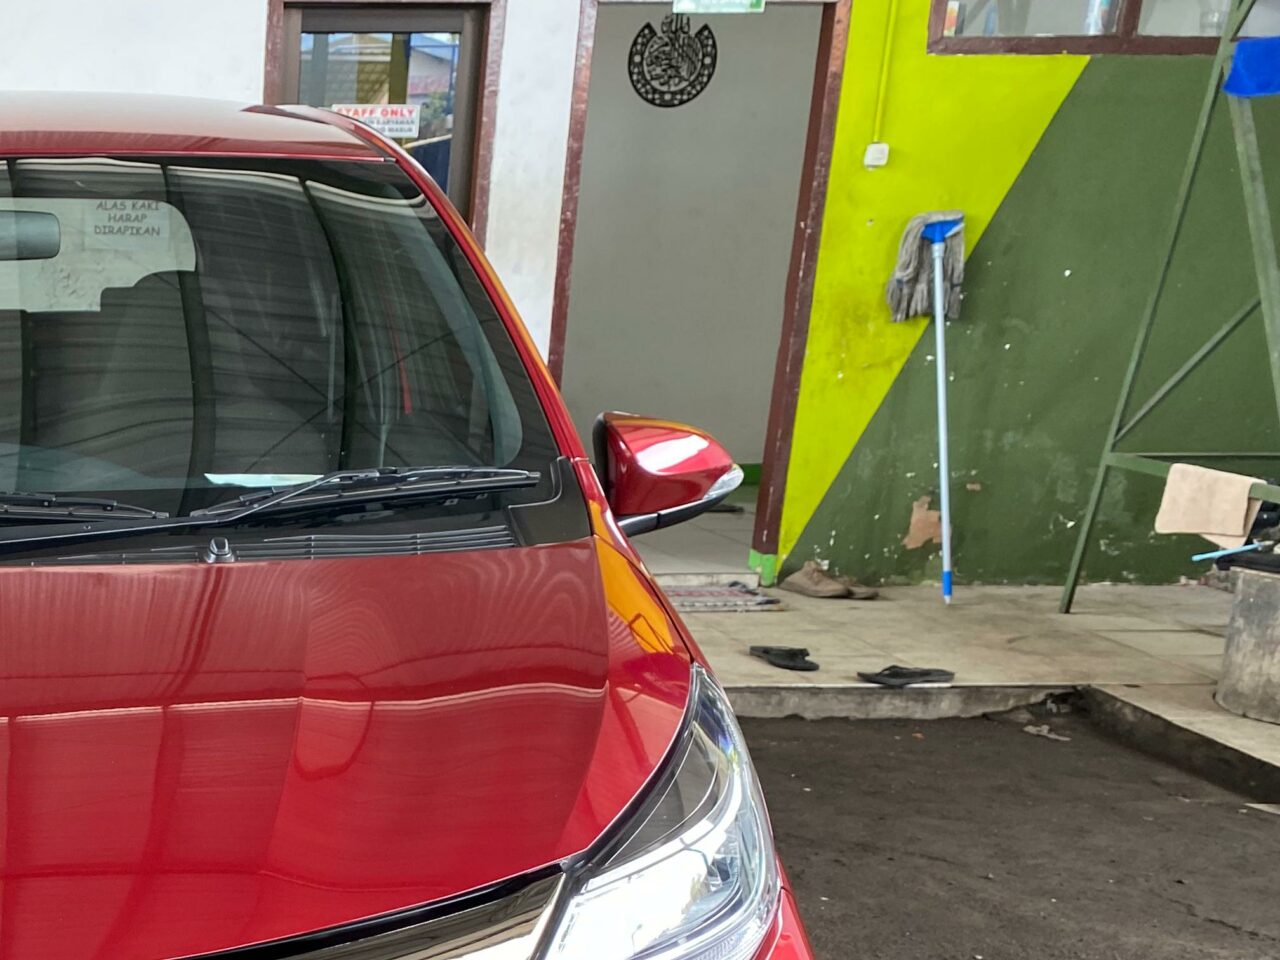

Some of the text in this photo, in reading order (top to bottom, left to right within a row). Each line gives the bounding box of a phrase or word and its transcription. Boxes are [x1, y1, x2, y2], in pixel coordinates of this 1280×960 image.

[336, 108, 415, 118] STAFF ONLY
[96, 200, 160, 211] ALAS KAKI
[107, 212, 148, 223] HARAP
[93, 224, 161, 236] DIRAPIKAN
